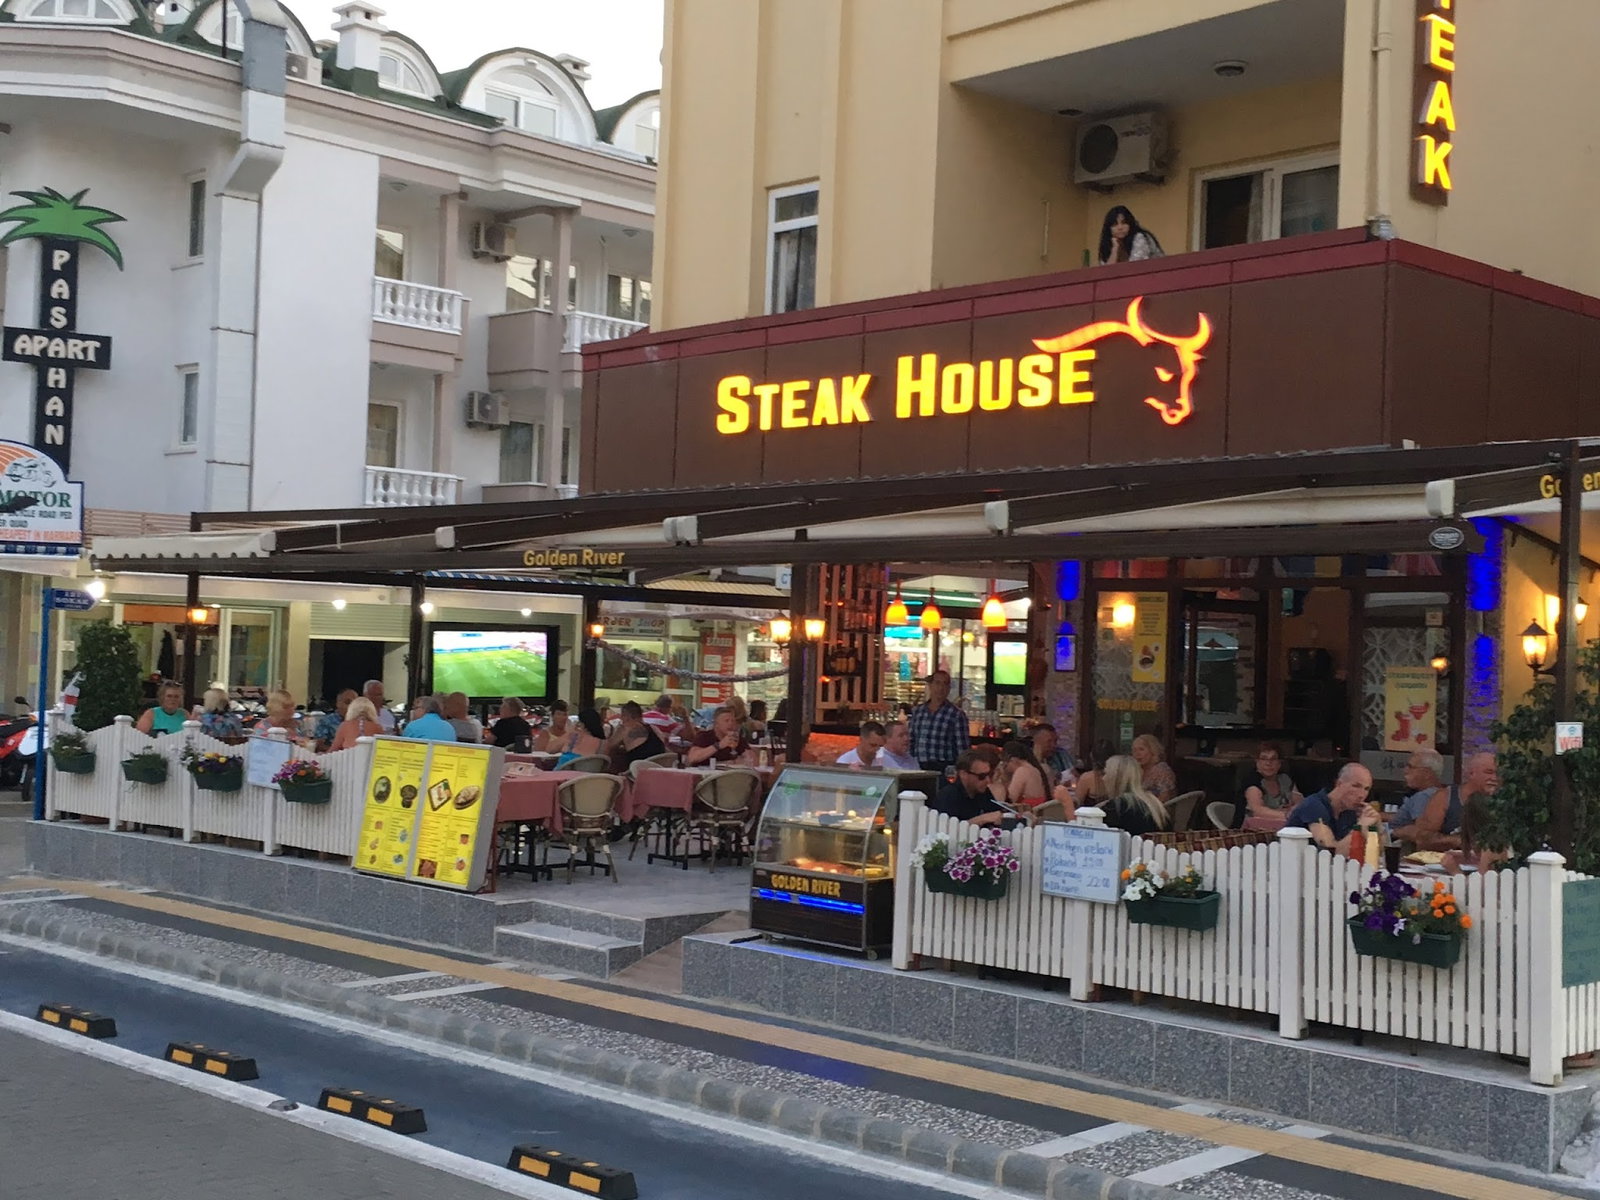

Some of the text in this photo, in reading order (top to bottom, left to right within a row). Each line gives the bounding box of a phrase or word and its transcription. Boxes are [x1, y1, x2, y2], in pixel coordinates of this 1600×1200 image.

[1424, 0, 1457, 191] EAK
[13, 333, 101, 362] APART
[523, 548, 625, 566] Golden River
[771, 873, 841, 898] GOLDEN RIVER
